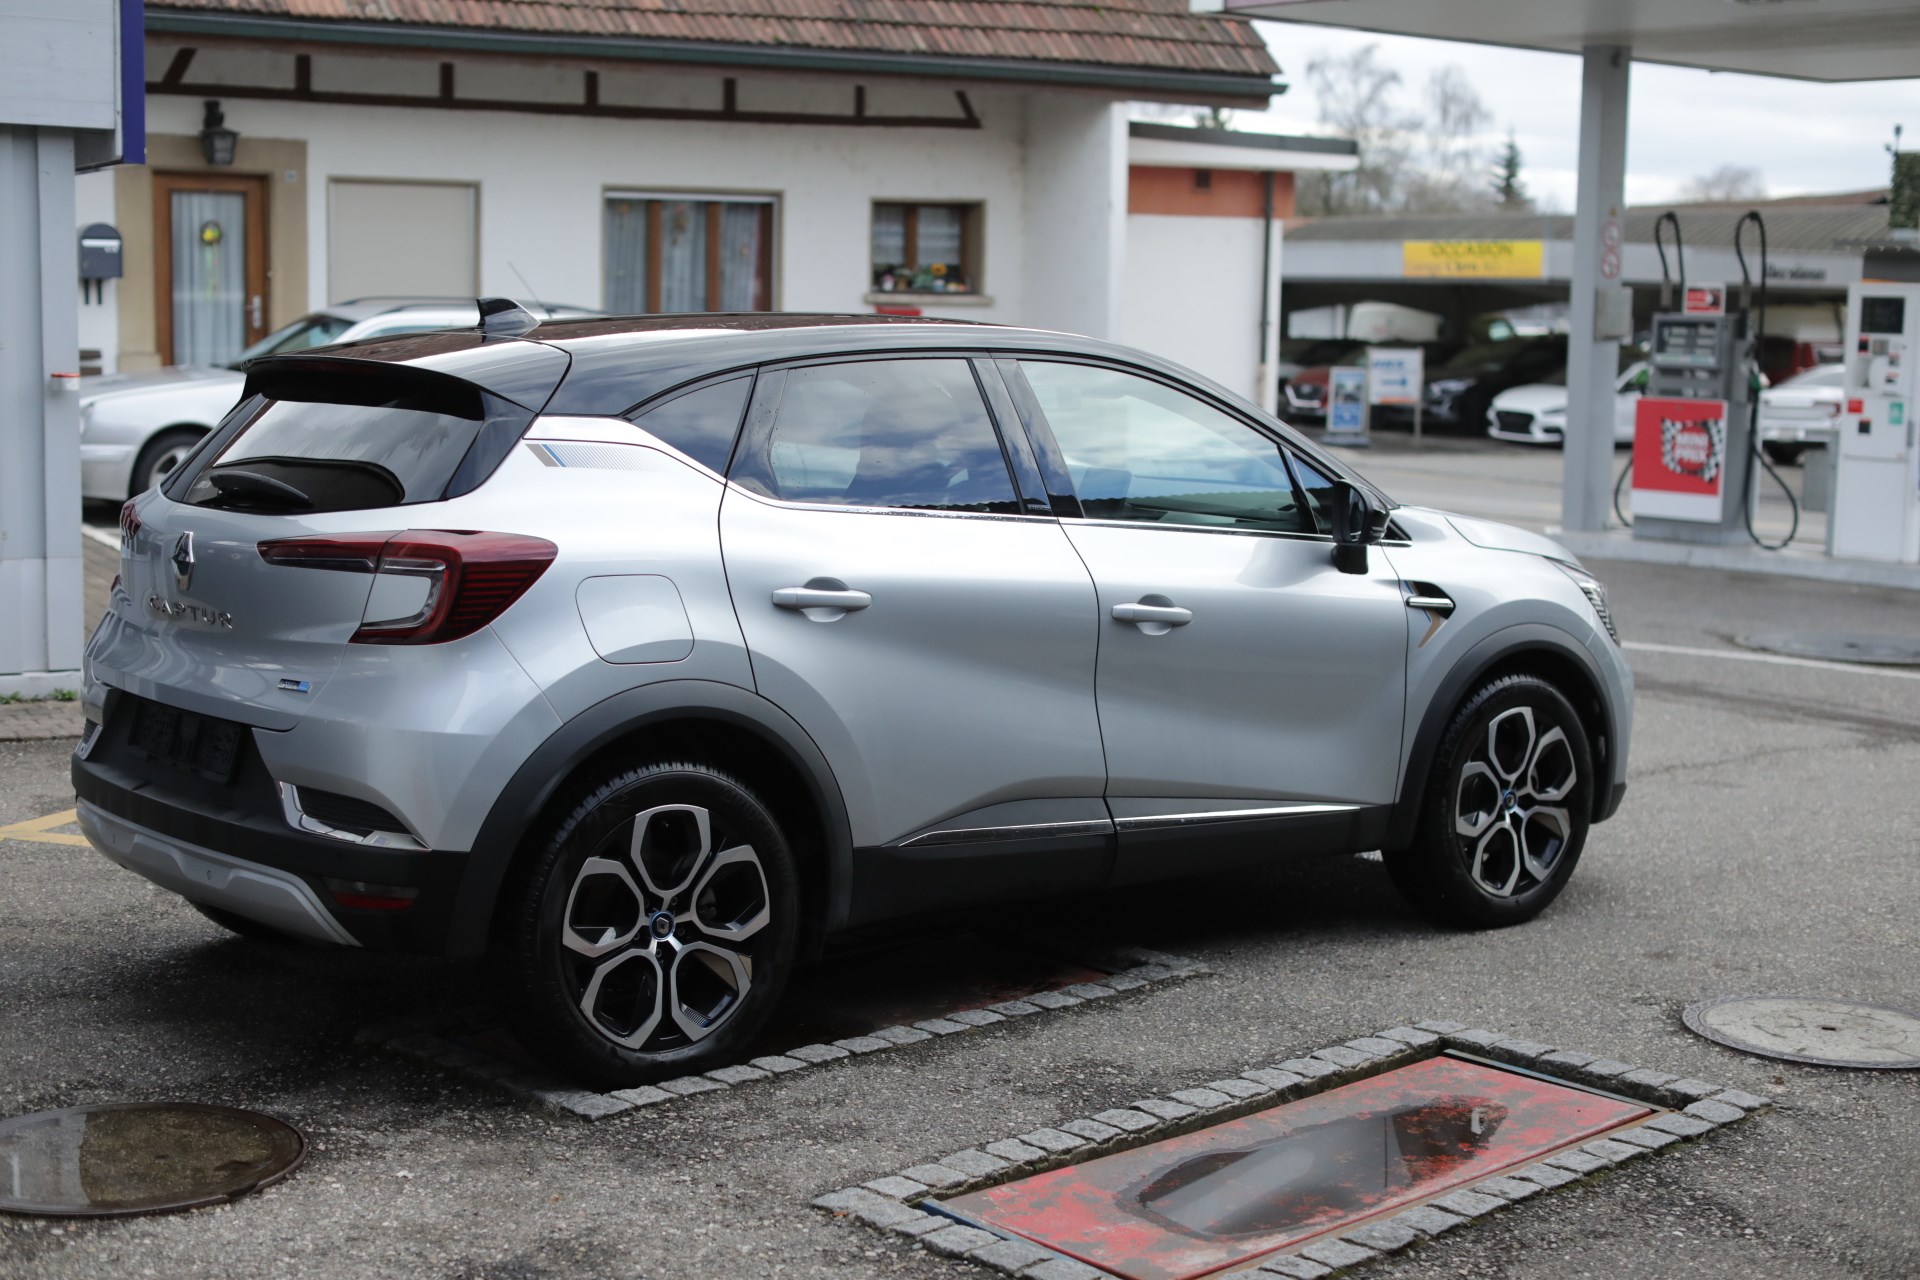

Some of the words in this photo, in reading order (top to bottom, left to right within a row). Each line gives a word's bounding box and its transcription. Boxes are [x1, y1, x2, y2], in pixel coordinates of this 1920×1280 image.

[1429, 241, 1514, 257] OCCASION
[1675, 431, 1709, 447] MINI
[1674, 447, 1708, 464] PRIX
[149, 594, 233, 629] CAPTUR
